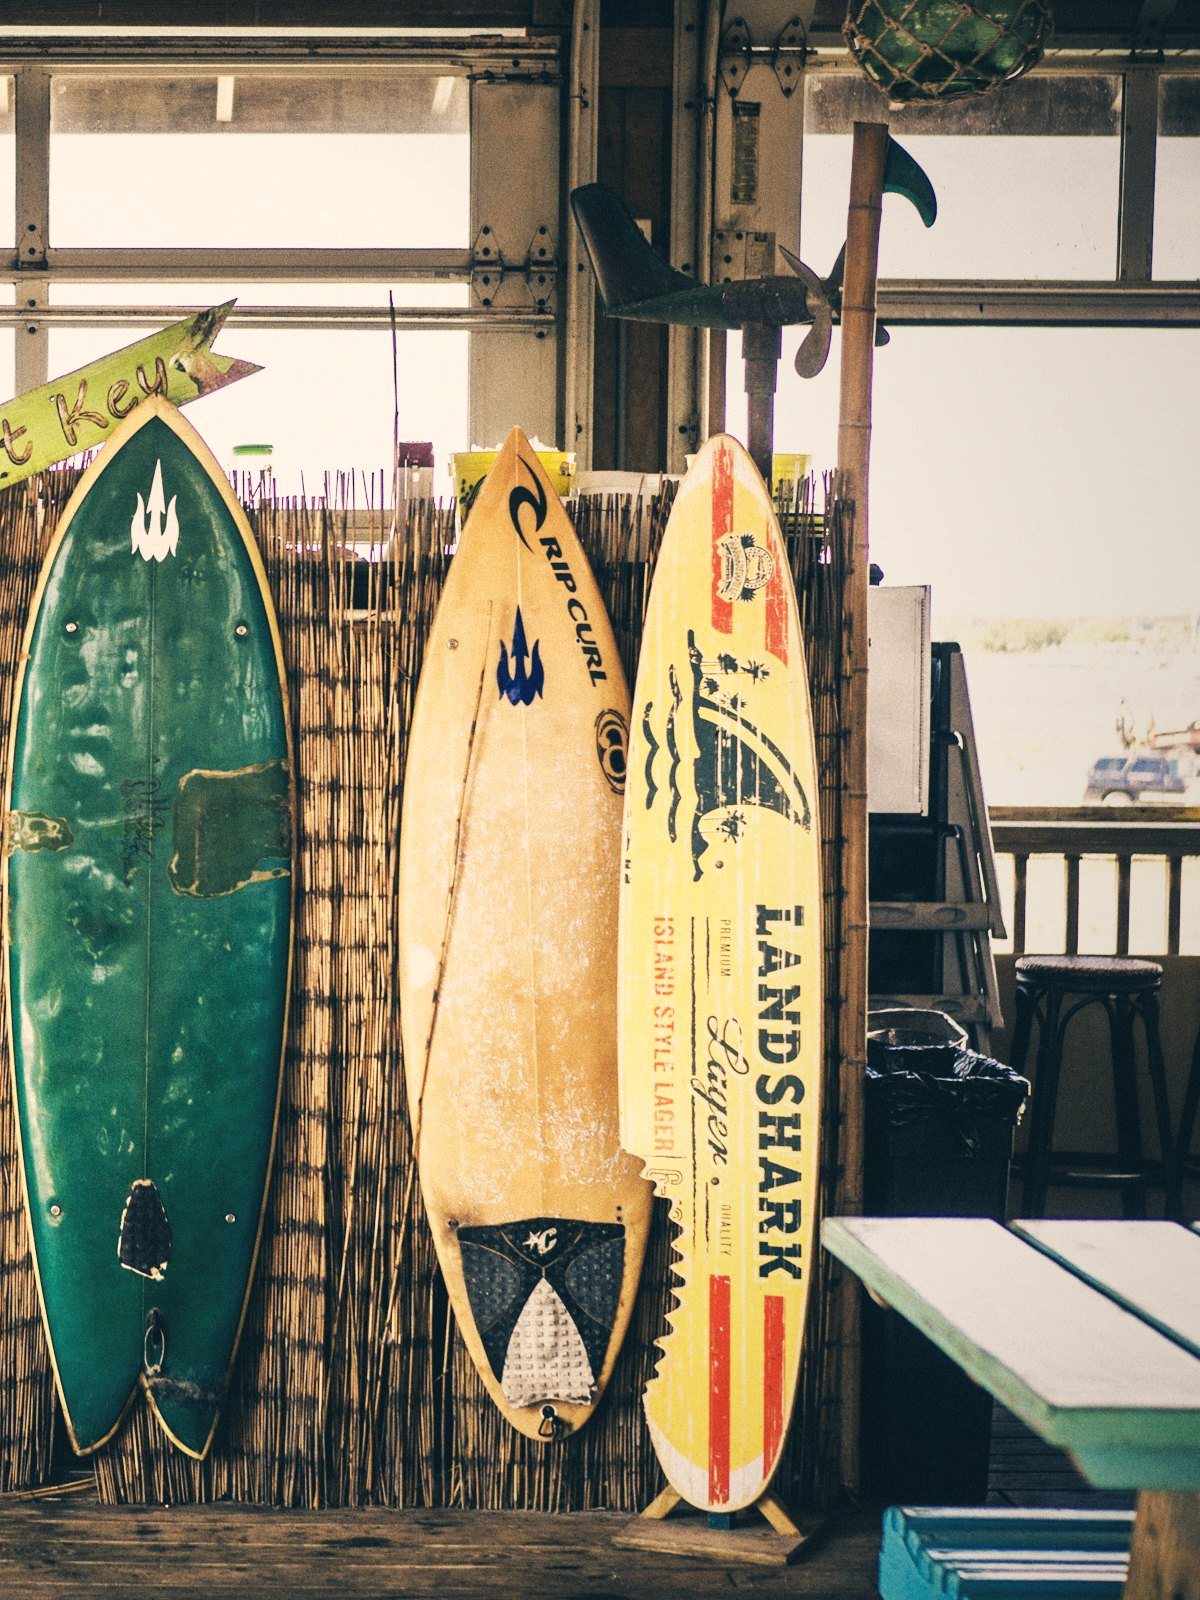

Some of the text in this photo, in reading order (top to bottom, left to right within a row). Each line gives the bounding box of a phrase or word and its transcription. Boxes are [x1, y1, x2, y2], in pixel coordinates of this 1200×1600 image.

[56, 356, 168, 446] Key
[538, 537, 608, 688] RIP CURL
[720, 919, 731, 977] PREMIUM
[654, 917, 675, 1150] ISLAND STYLE LAGER
[691, 1016, 749, 1166] Lager
[755, 905, 805, 1279] LANDSHARK
